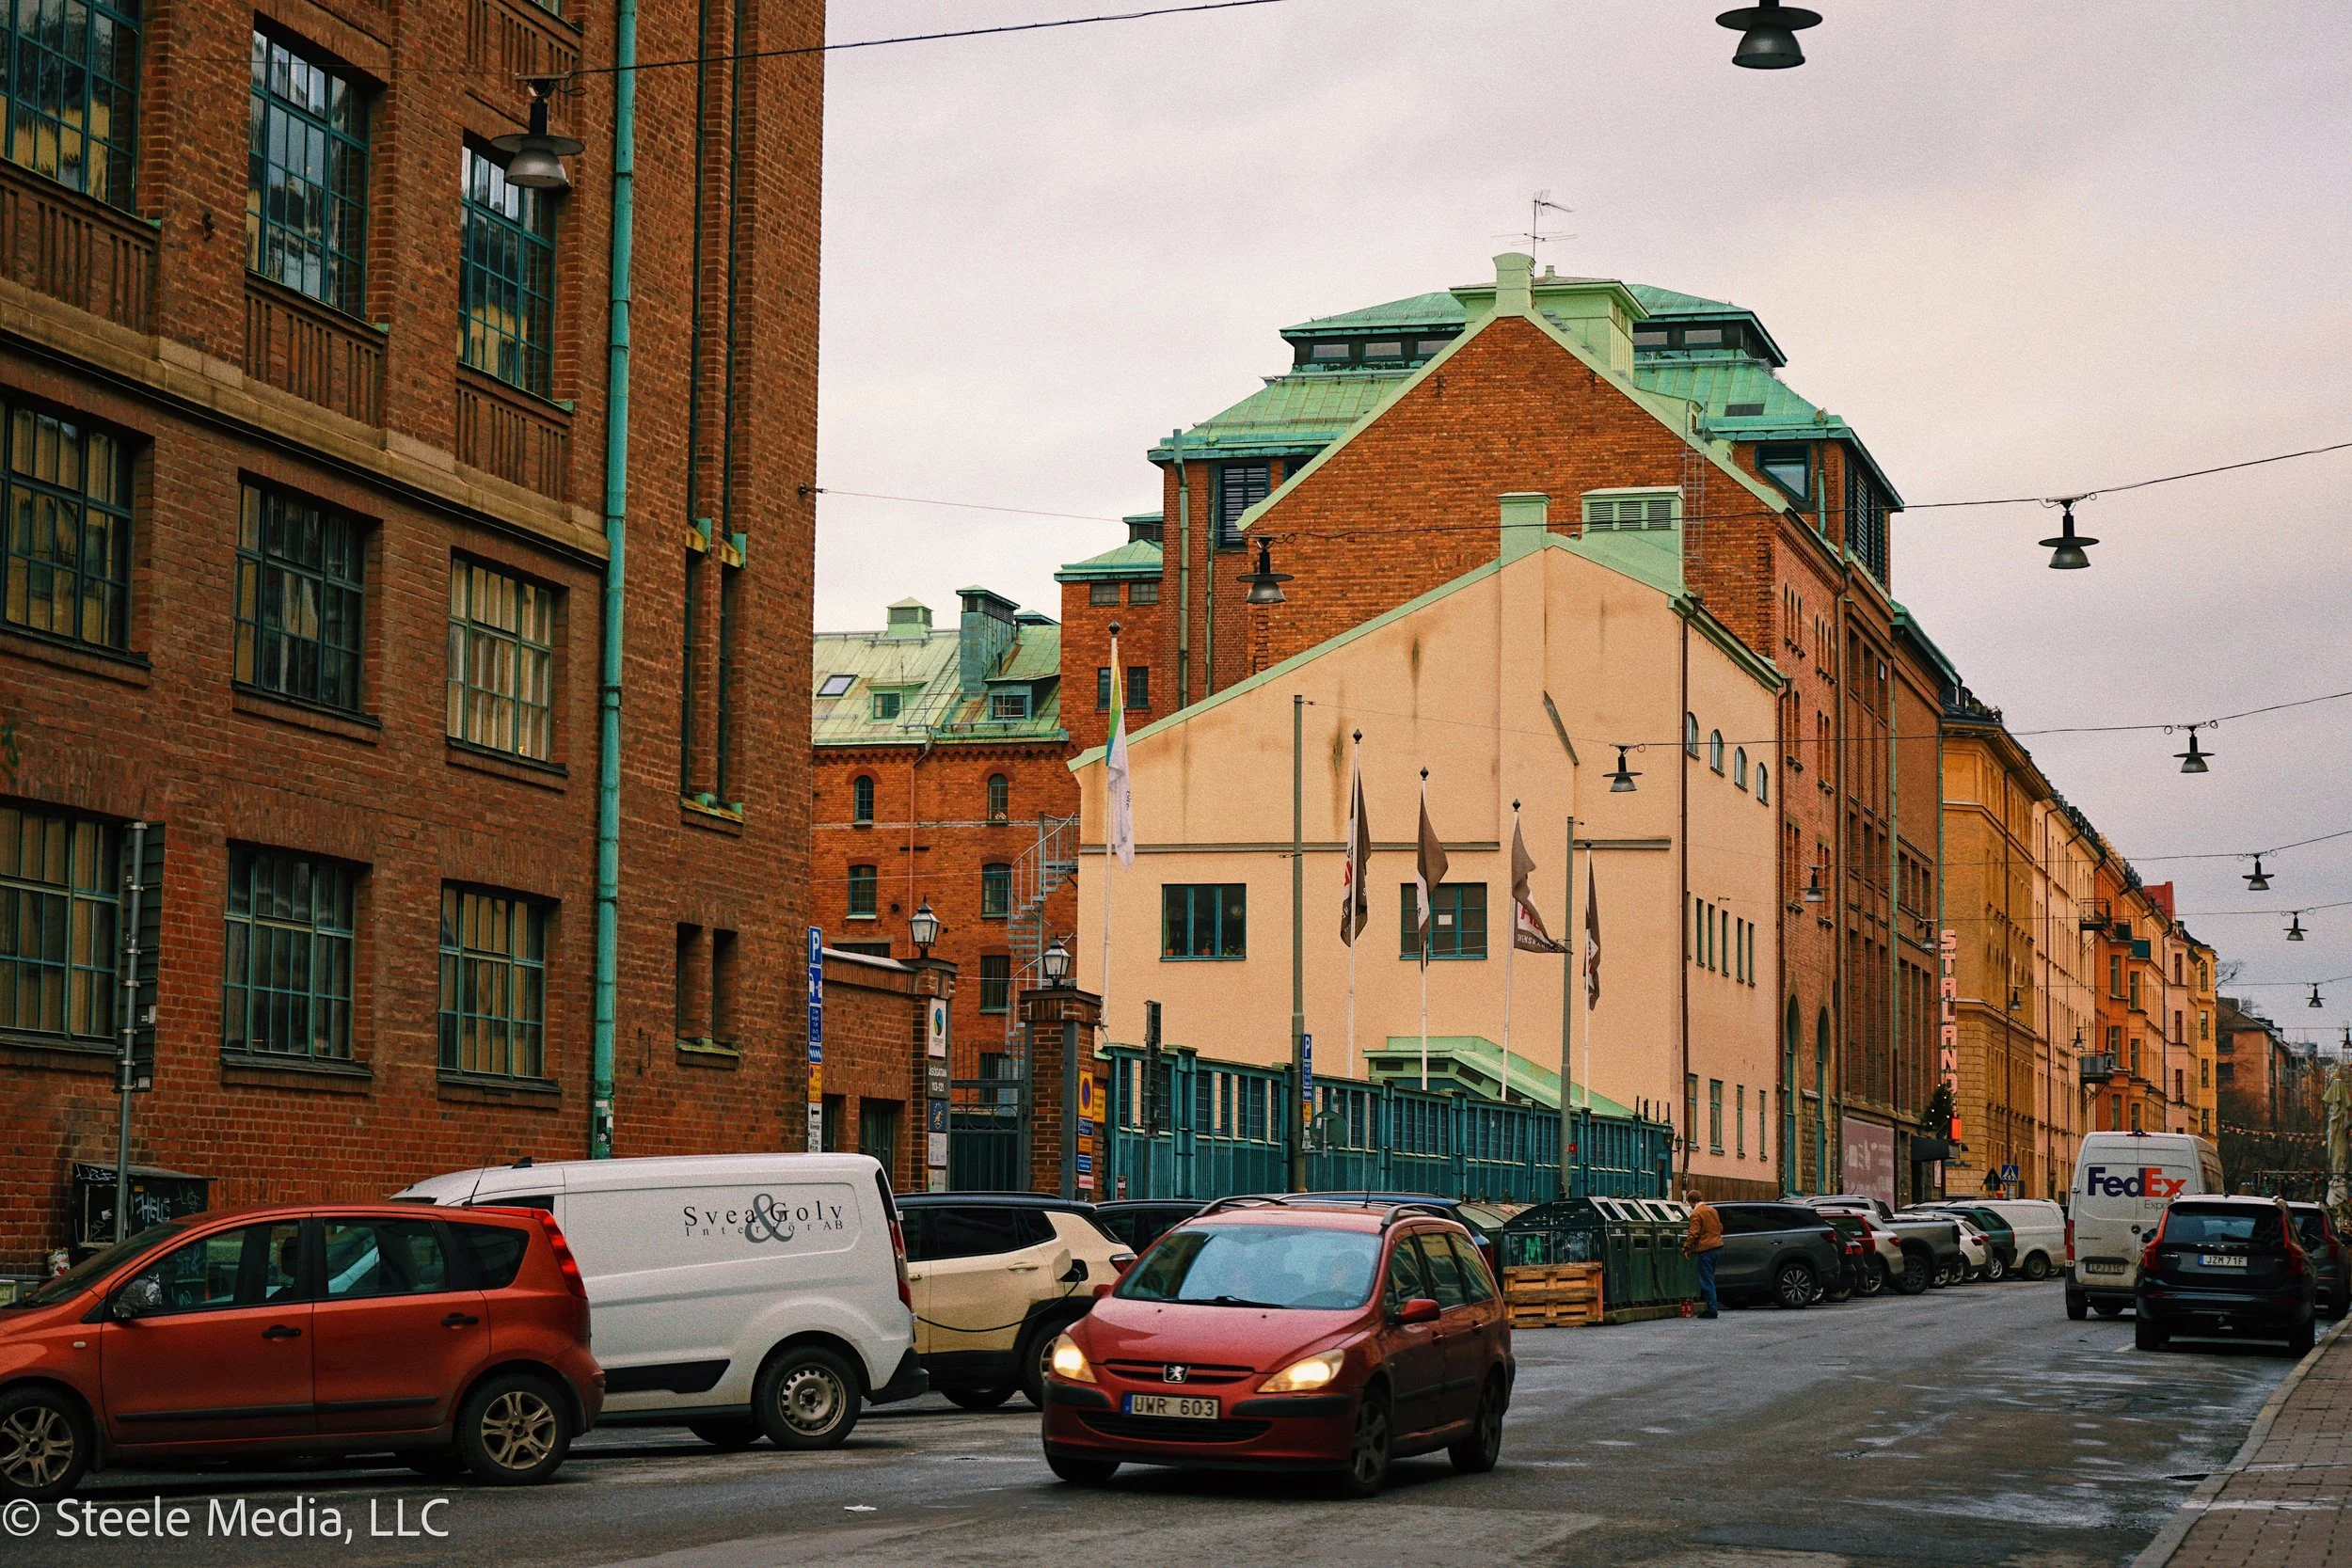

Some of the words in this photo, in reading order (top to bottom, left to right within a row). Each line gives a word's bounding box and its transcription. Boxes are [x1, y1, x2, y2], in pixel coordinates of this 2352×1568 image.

[812, 930, 820, 961] P
[1304, 1036, 1311, 1056] P
[2088, 1166, 2187, 1198] FedEx
[683, 1206, 755, 1227] Svea
[745, 1193, 794, 1243] &
[771, 1200, 842, 1223] Golv
[686, 1222, 812, 1237] Interiör
[823, 1220, 843, 1231] AB
[2206, 1256, 2224, 1264] JZM
[2226, 1257, 2244, 1265] 71F
[1180, 1400, 1215, 1417] 603
